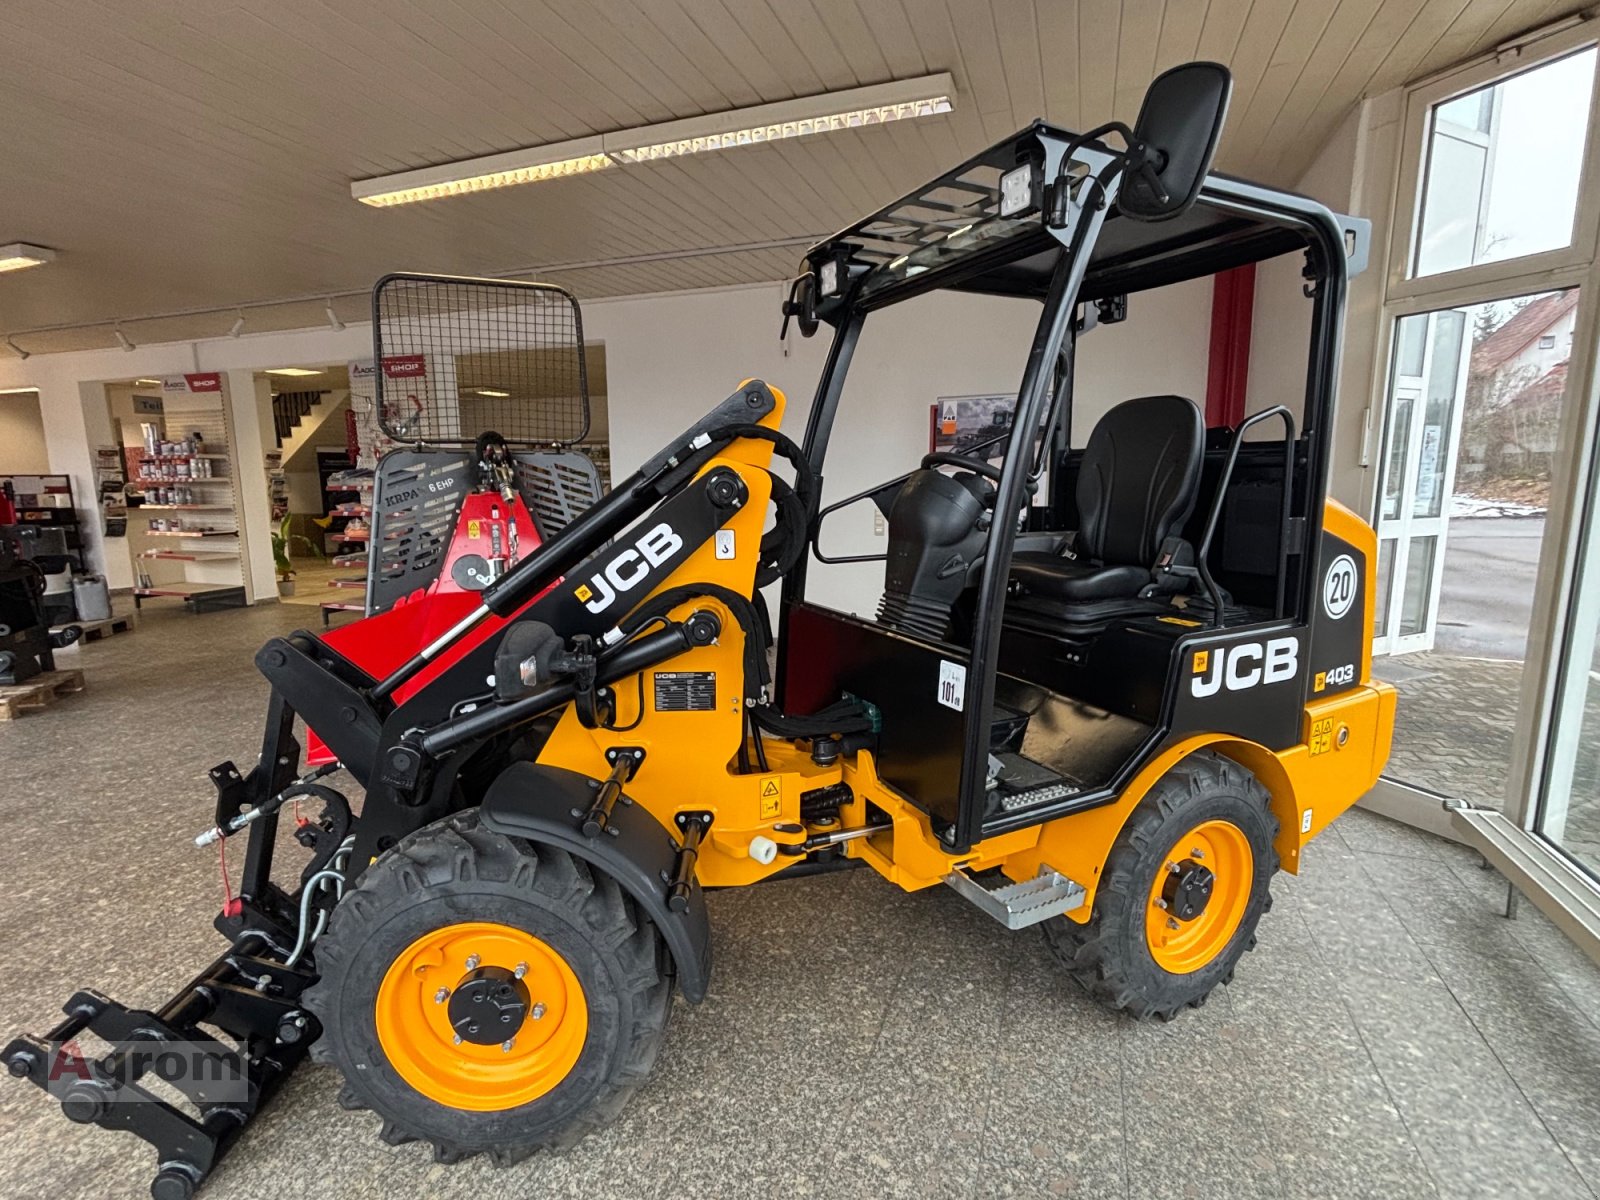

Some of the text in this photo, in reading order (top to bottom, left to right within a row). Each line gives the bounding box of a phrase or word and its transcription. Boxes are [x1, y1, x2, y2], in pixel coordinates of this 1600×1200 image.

[390, 363, 419, 372] SHOP
[428, 483, 436, 492] 6
[436, 478, 454, 490] EHP
[585, 523, 683, 614] JCB
[1330, 570, 1351, 605] 20
[1192, 636, 1299, 698] JCB
[1325, 664, 1354, 685] 403
[942, 680, 955, 704] 101
